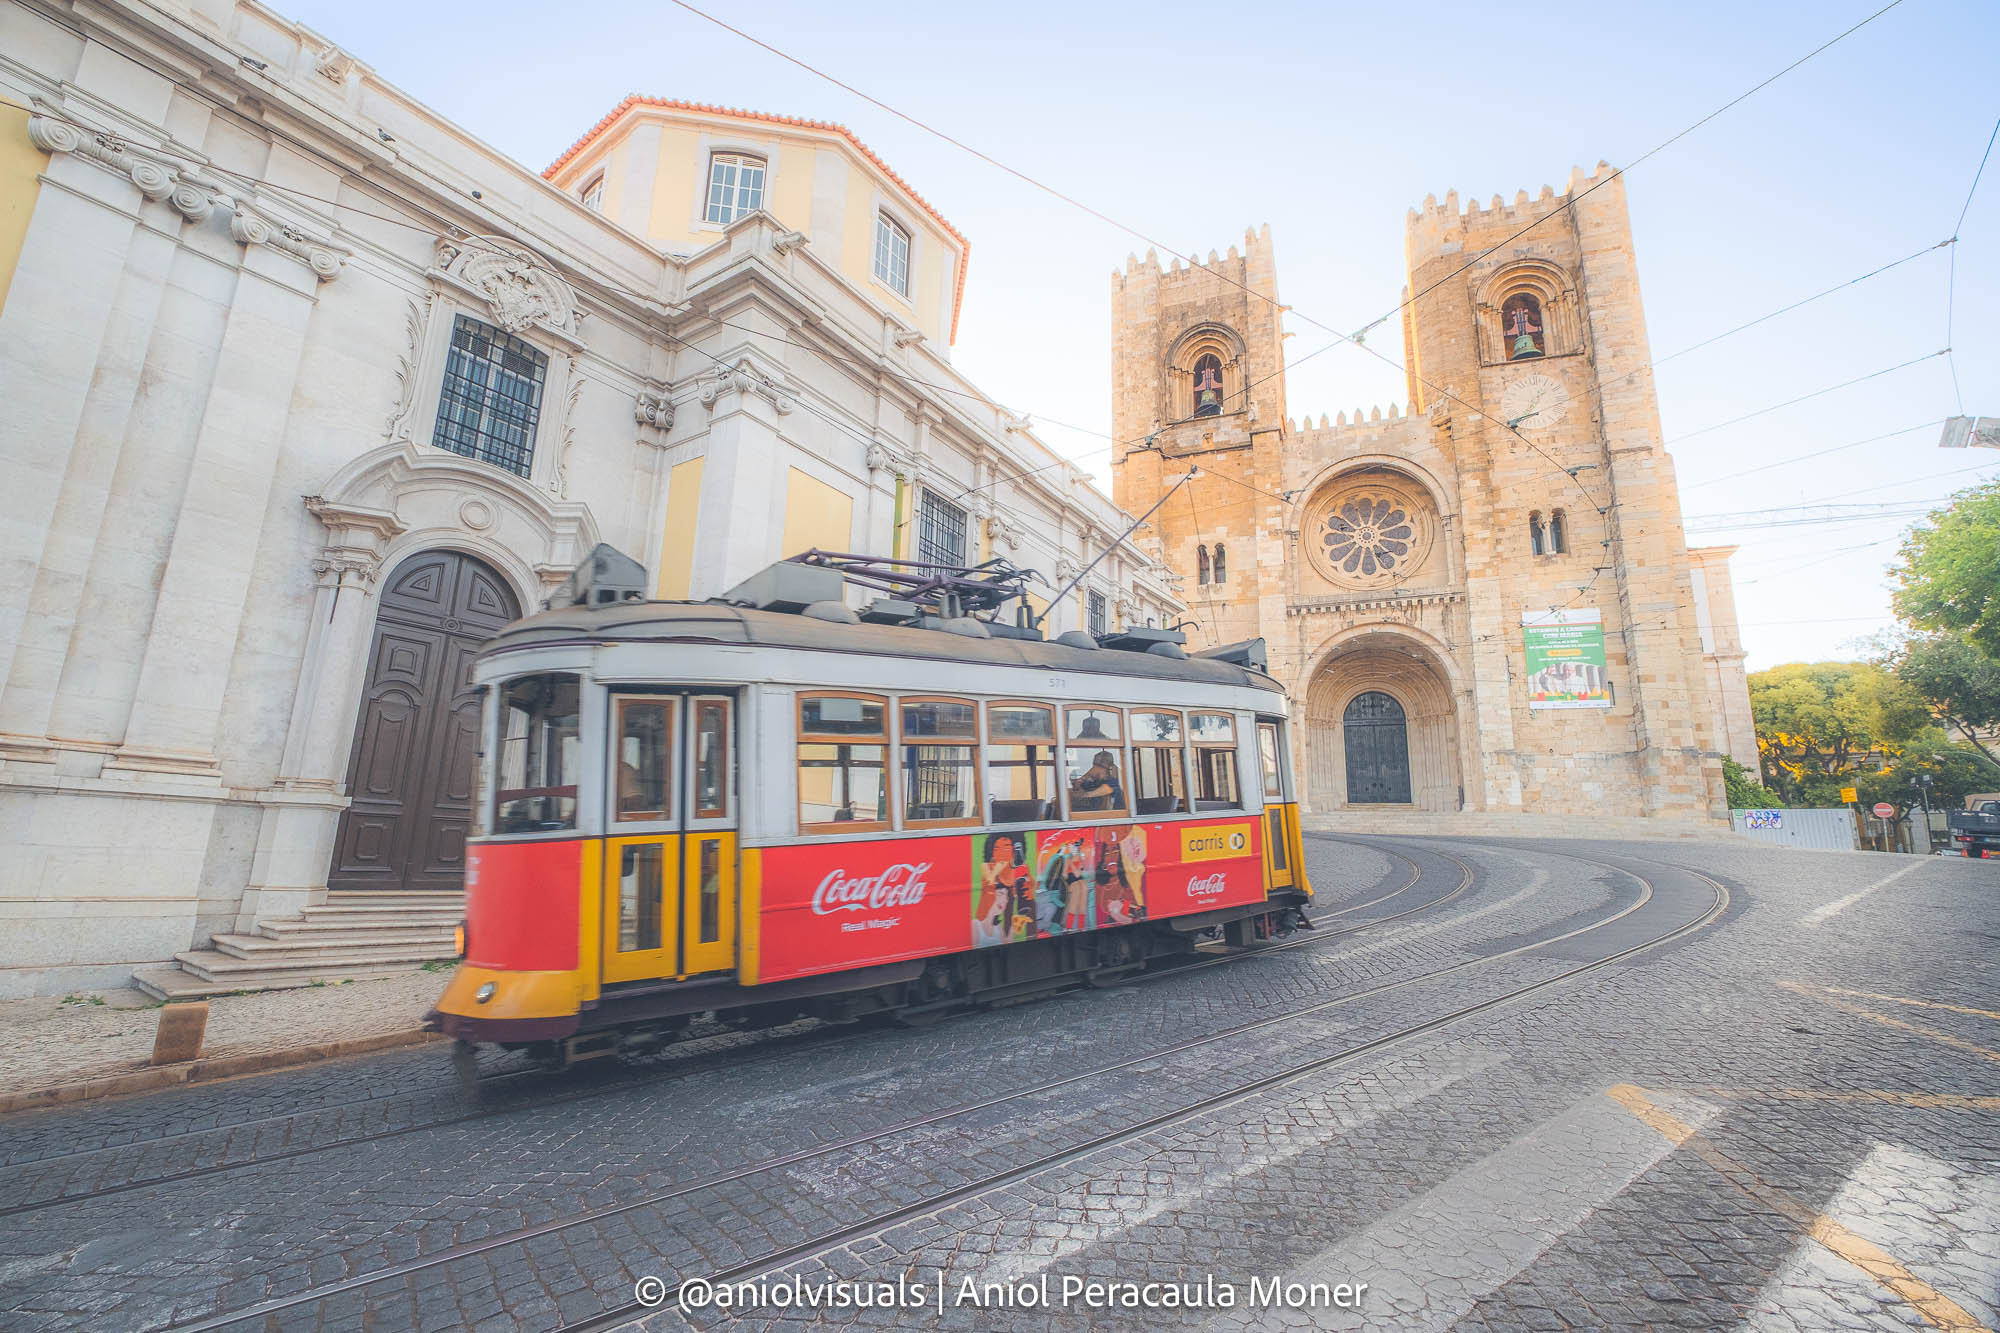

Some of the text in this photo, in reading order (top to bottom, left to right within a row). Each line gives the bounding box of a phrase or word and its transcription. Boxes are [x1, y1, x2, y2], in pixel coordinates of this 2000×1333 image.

[1189, 833, 1224, 852] carris
[841, 917, 900, 932] Real Magic
